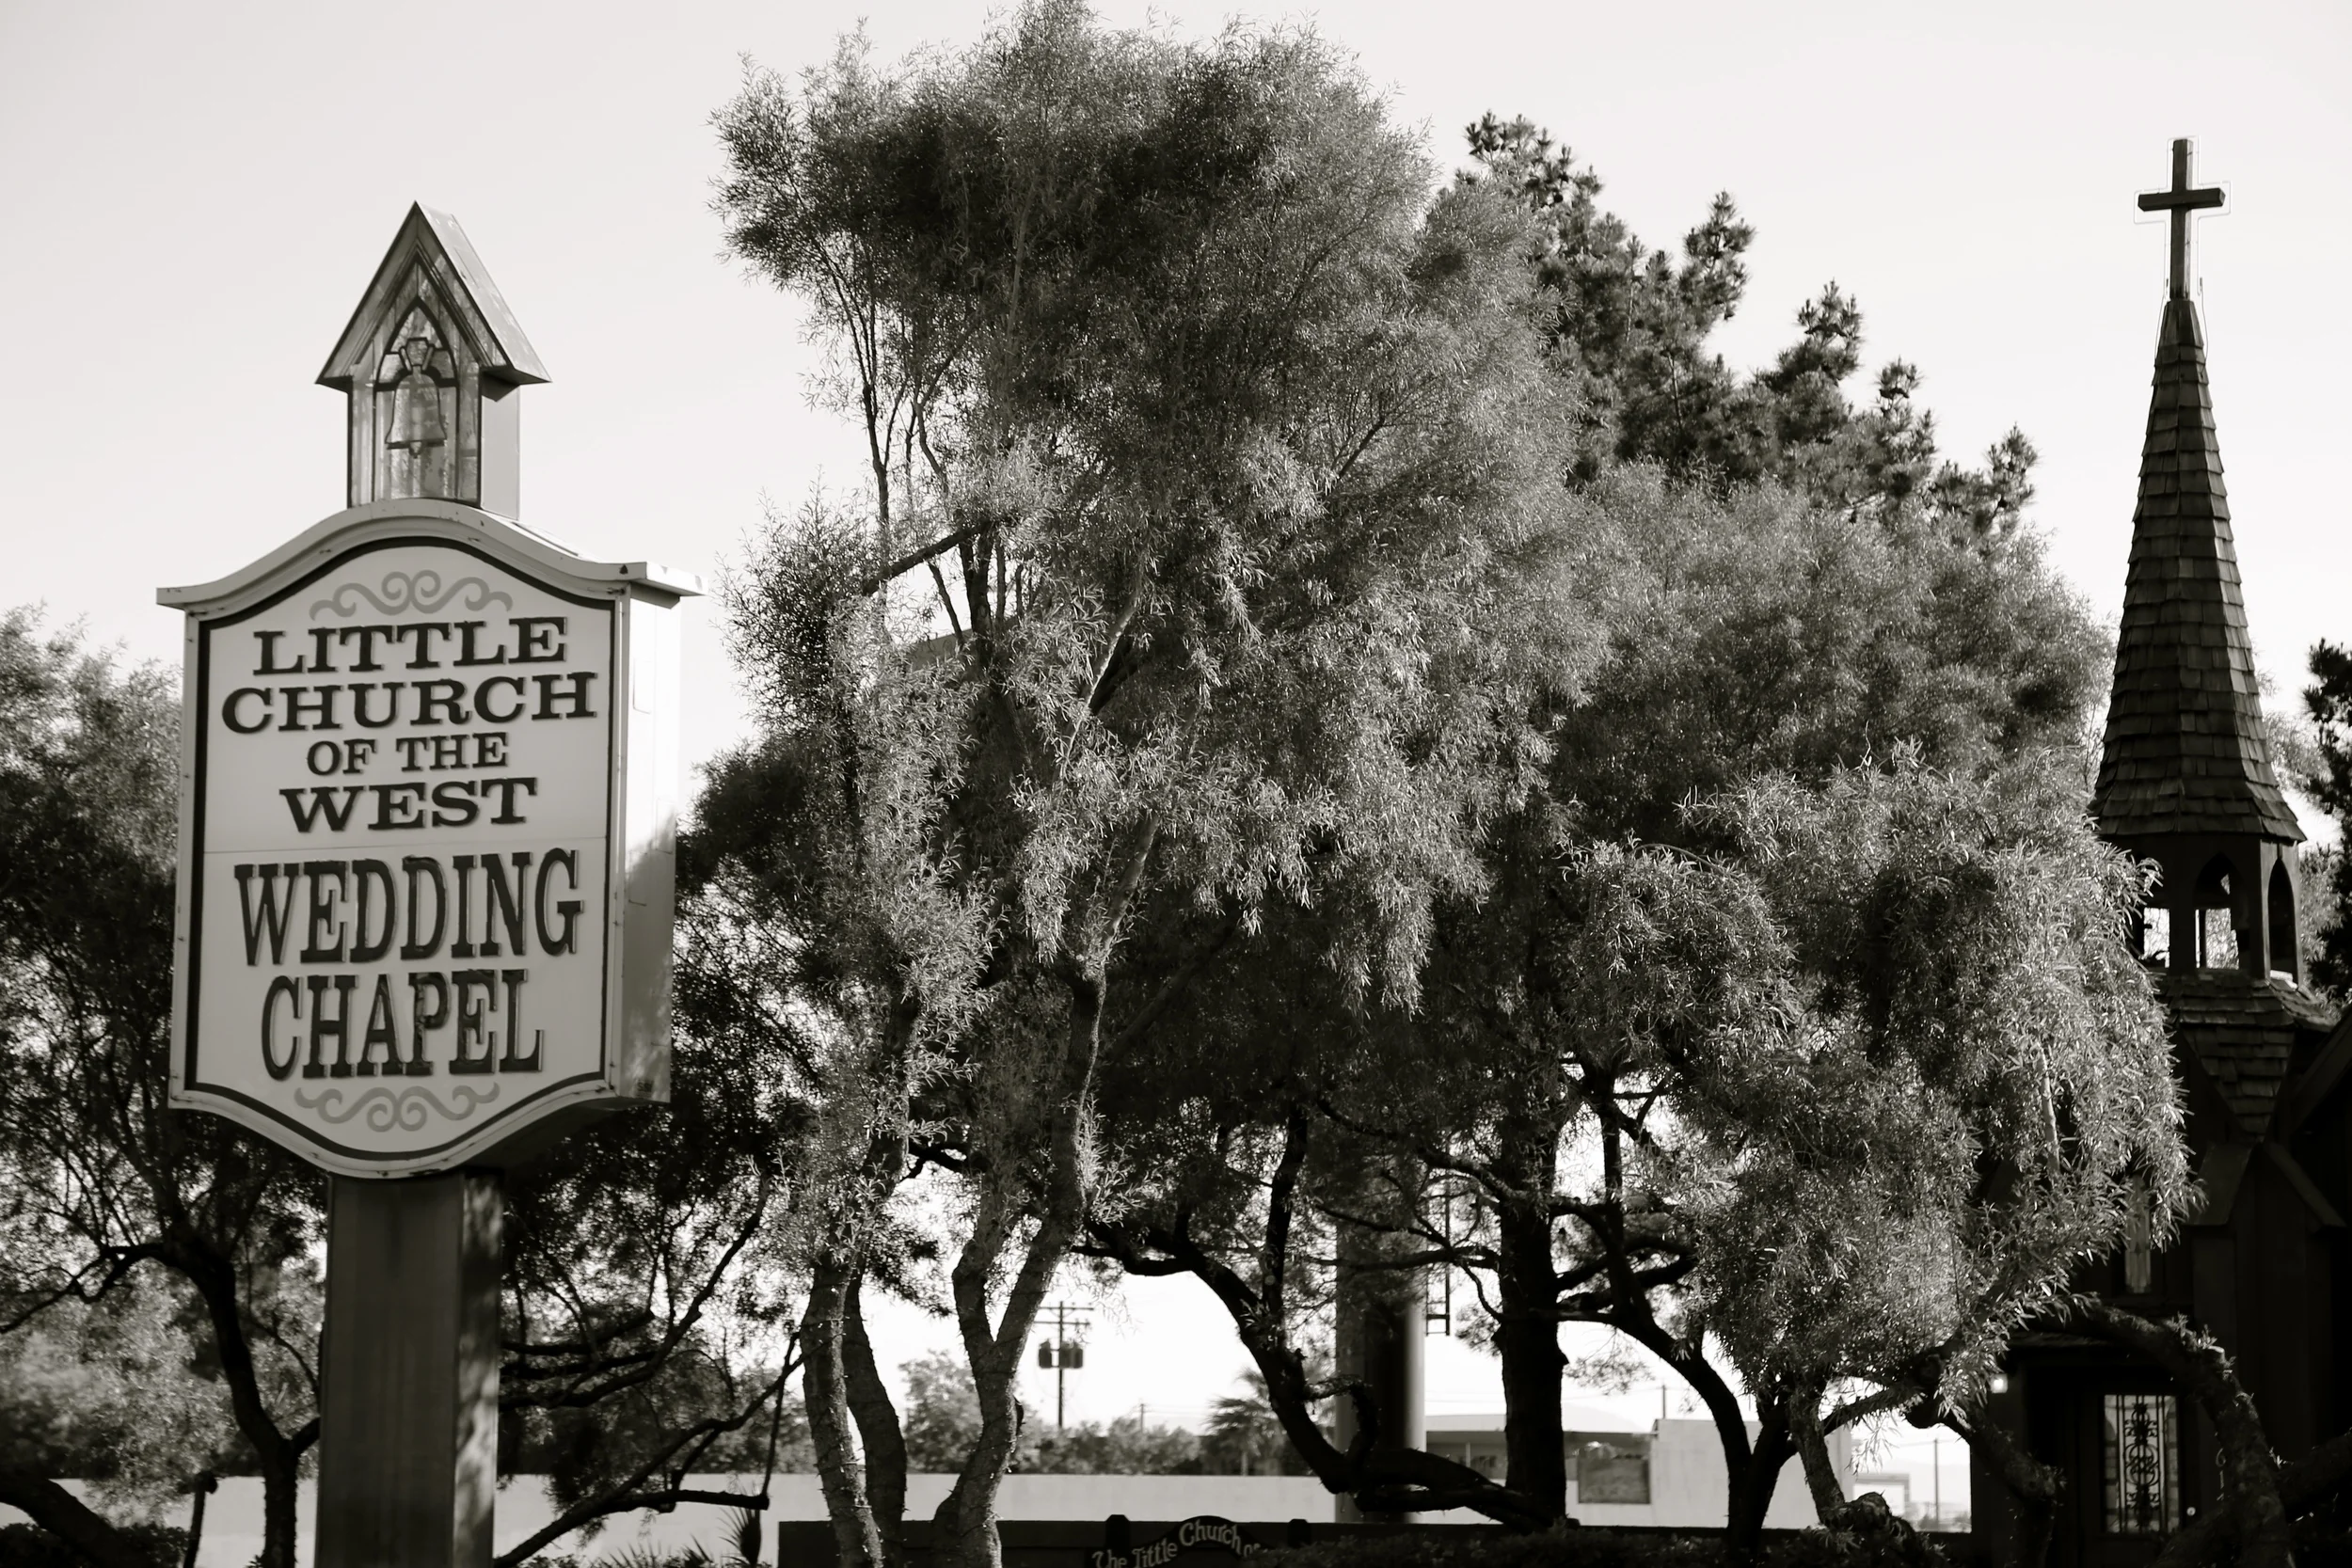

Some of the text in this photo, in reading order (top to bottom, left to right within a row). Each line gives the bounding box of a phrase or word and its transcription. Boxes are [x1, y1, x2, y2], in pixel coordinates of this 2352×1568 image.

[252, 616, 566, 676] LITTLE
[221, 672, 597, 734] CHURCH
[307, 732, 508, 776] OF THE
[278, 777, 537, 833] WEST
[233, 847, 584, 967] WEDDING
[261, 969, 544, 1080] CHAPEL
[1179, 1519, 1242, 1555] Church
